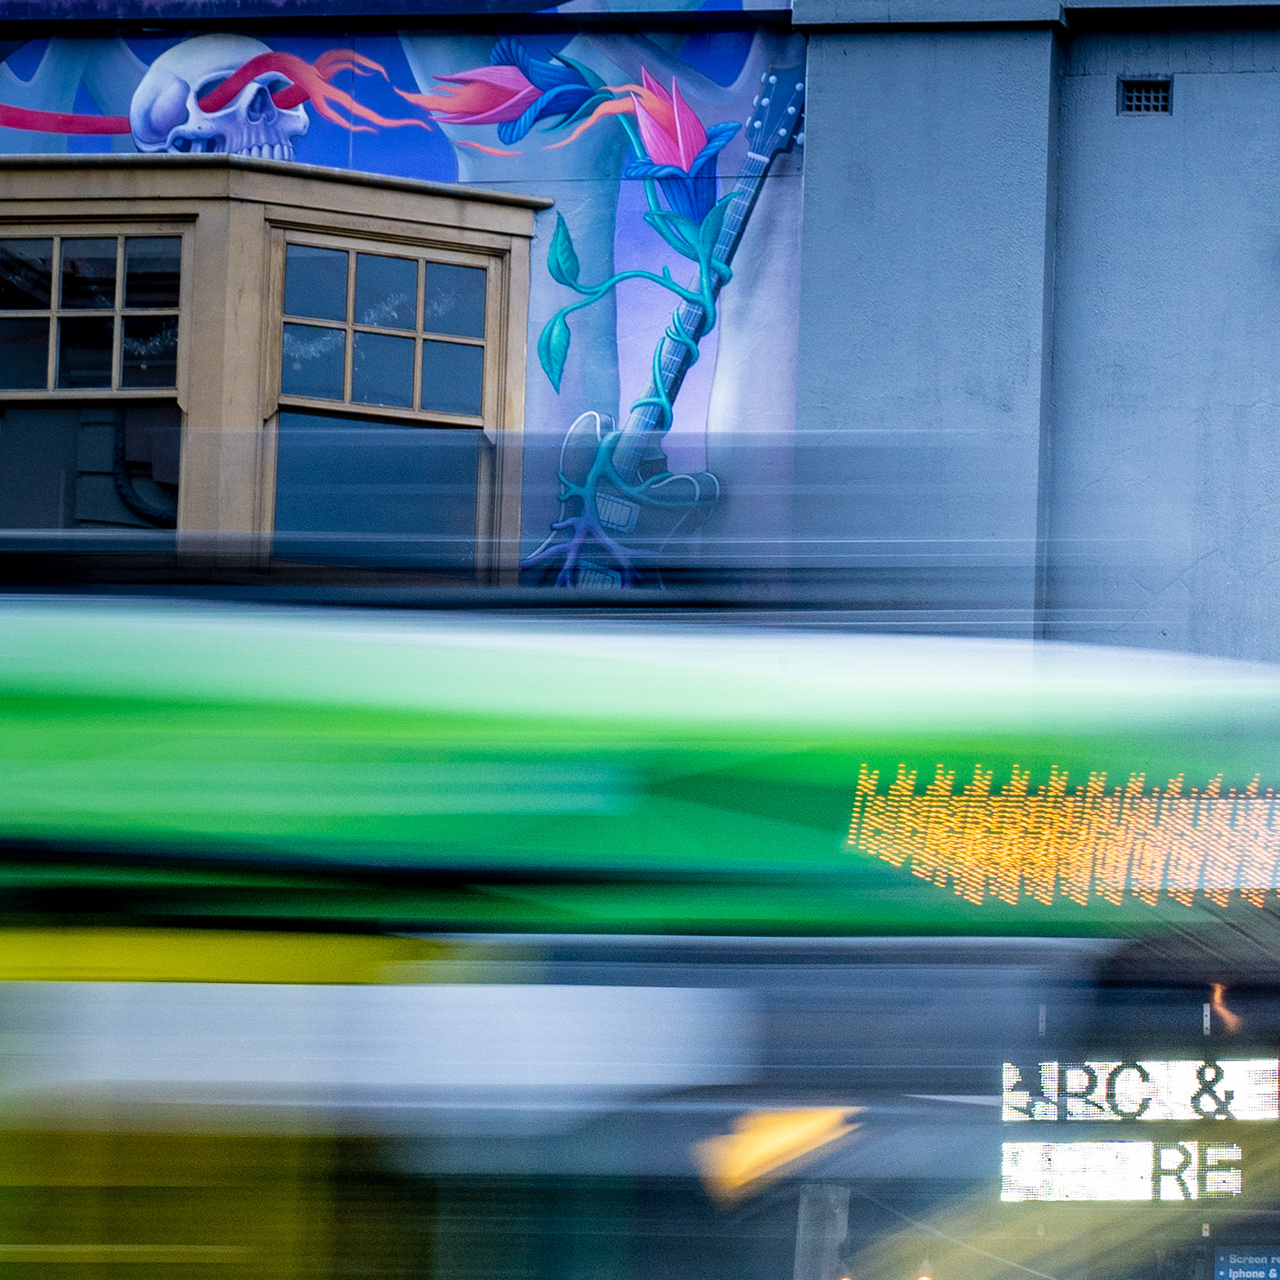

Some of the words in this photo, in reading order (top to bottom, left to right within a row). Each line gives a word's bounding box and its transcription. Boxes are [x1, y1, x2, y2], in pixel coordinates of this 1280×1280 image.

[1228, 1254, 1268, 1265] Screen
[1228, 1269, 1266, 1280] Iphone
[1268, 1269, 1277, 1279] &
